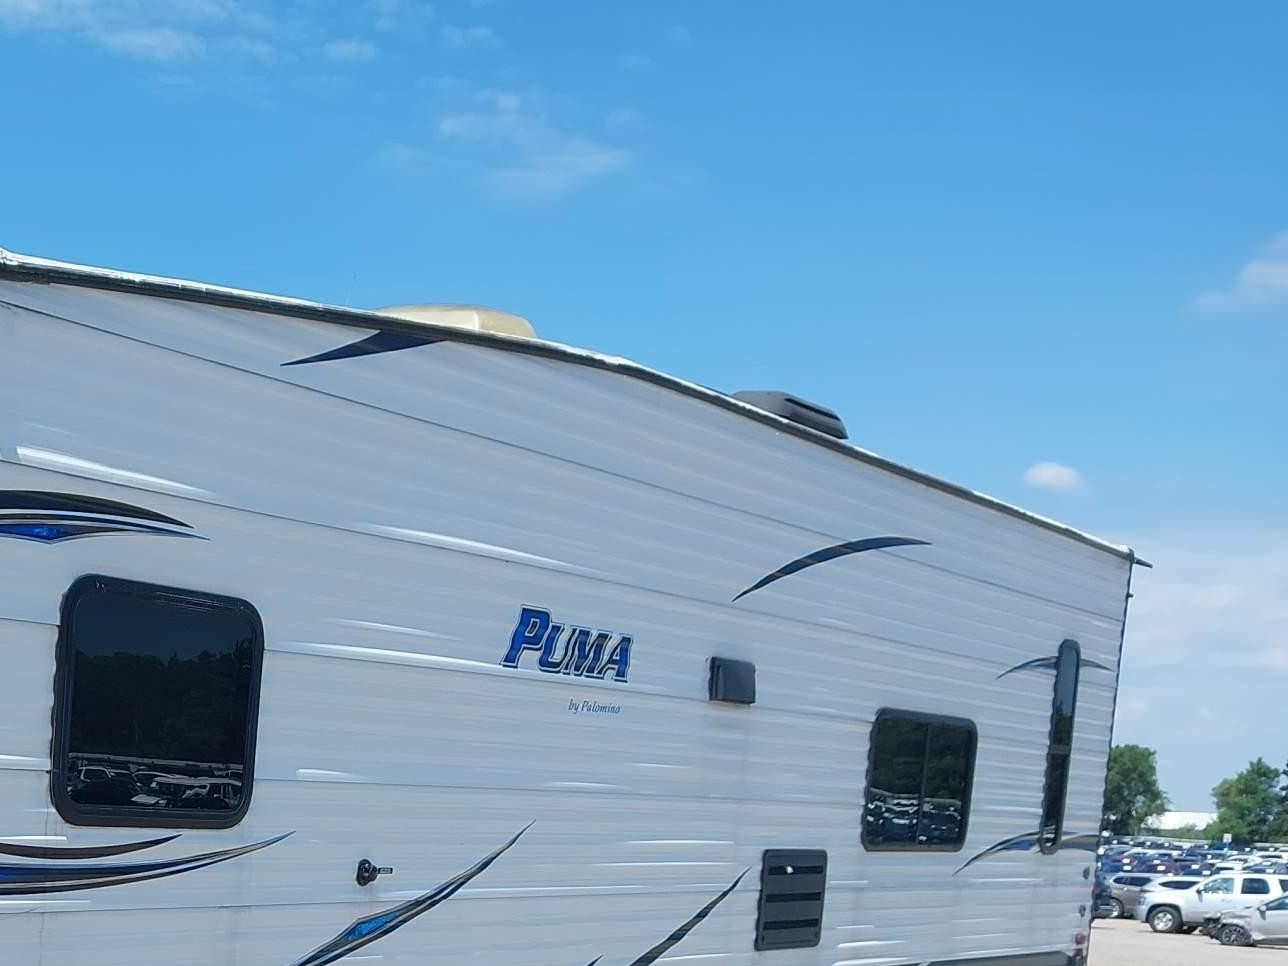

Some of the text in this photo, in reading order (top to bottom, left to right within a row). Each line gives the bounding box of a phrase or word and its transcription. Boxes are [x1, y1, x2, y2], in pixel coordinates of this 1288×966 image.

[499, 604, 633, 683] PUMA
[568, 698, 622, 715] by Palomino
